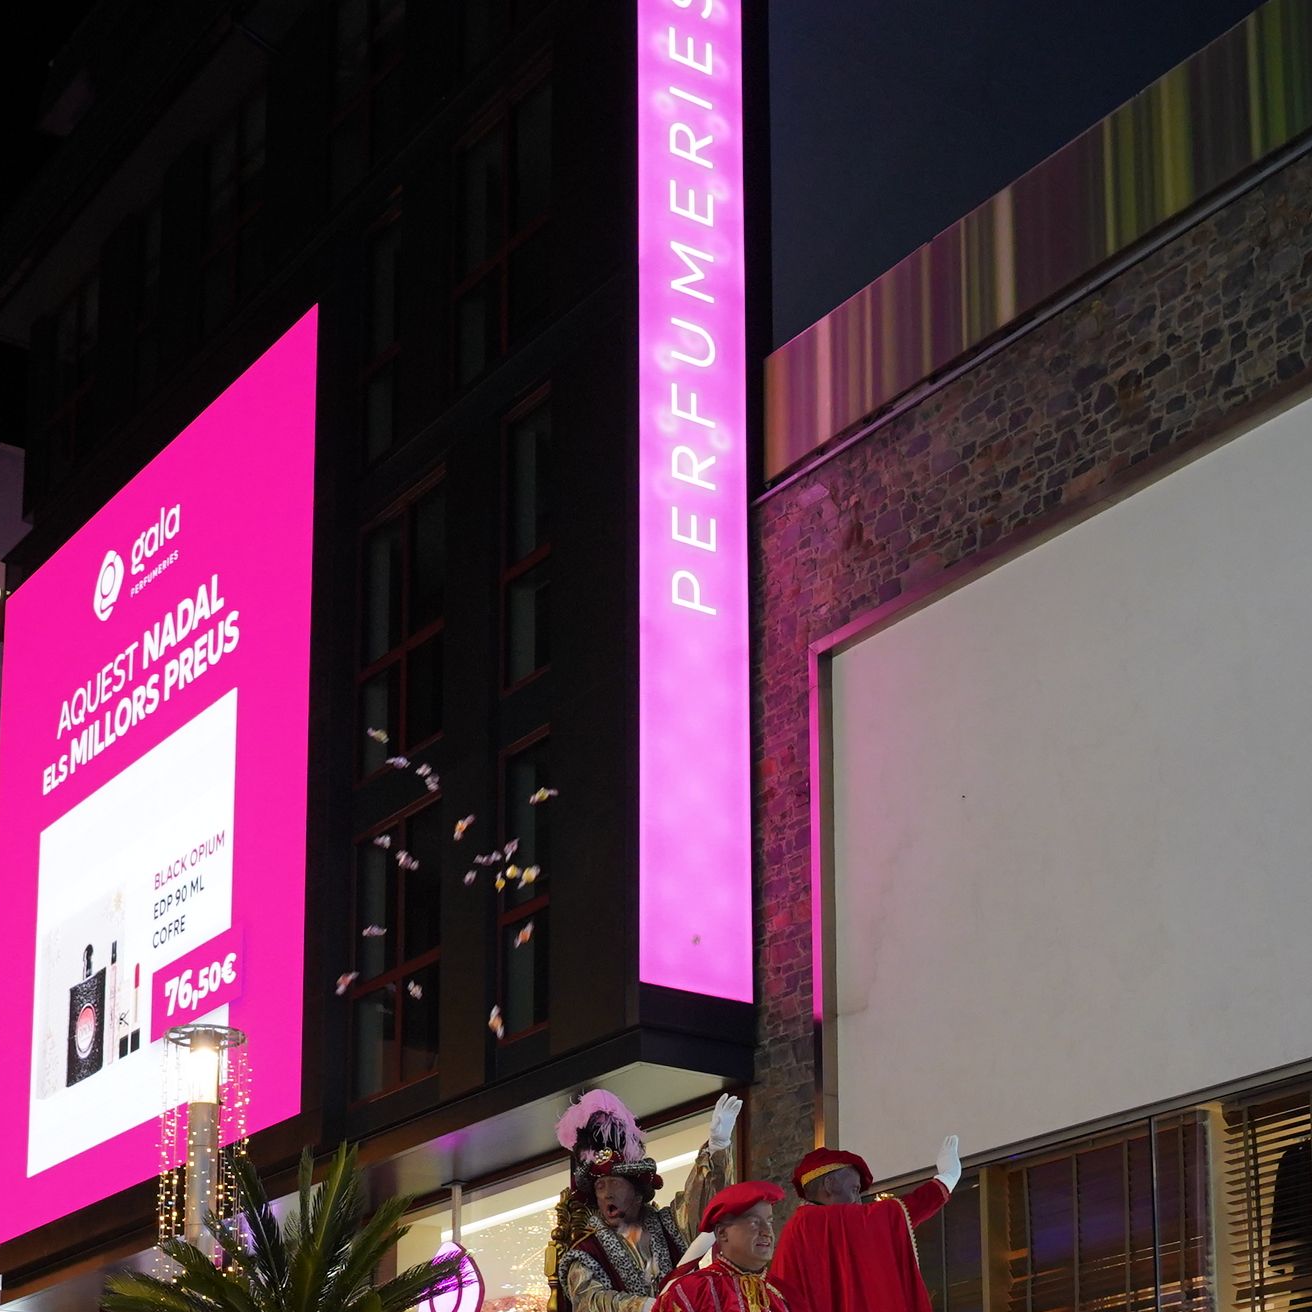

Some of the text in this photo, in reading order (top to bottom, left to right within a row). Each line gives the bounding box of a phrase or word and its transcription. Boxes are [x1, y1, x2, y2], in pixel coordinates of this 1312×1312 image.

[131, 504, 180, 575] gala
[130, 549, 179, 598] PERFUMERIES
[57, 574, 224, 739] AQUEST NADAL
[43, 610, 239, 796] ELS MILLORS PREUS
[154, 830, 225, 890] BLACK OPIUM
[153, 874, 205, 920] EDP 90 ML
[152, 915, 186, 949] COFRE
[165, 952, 237, 1016] 76,50€
